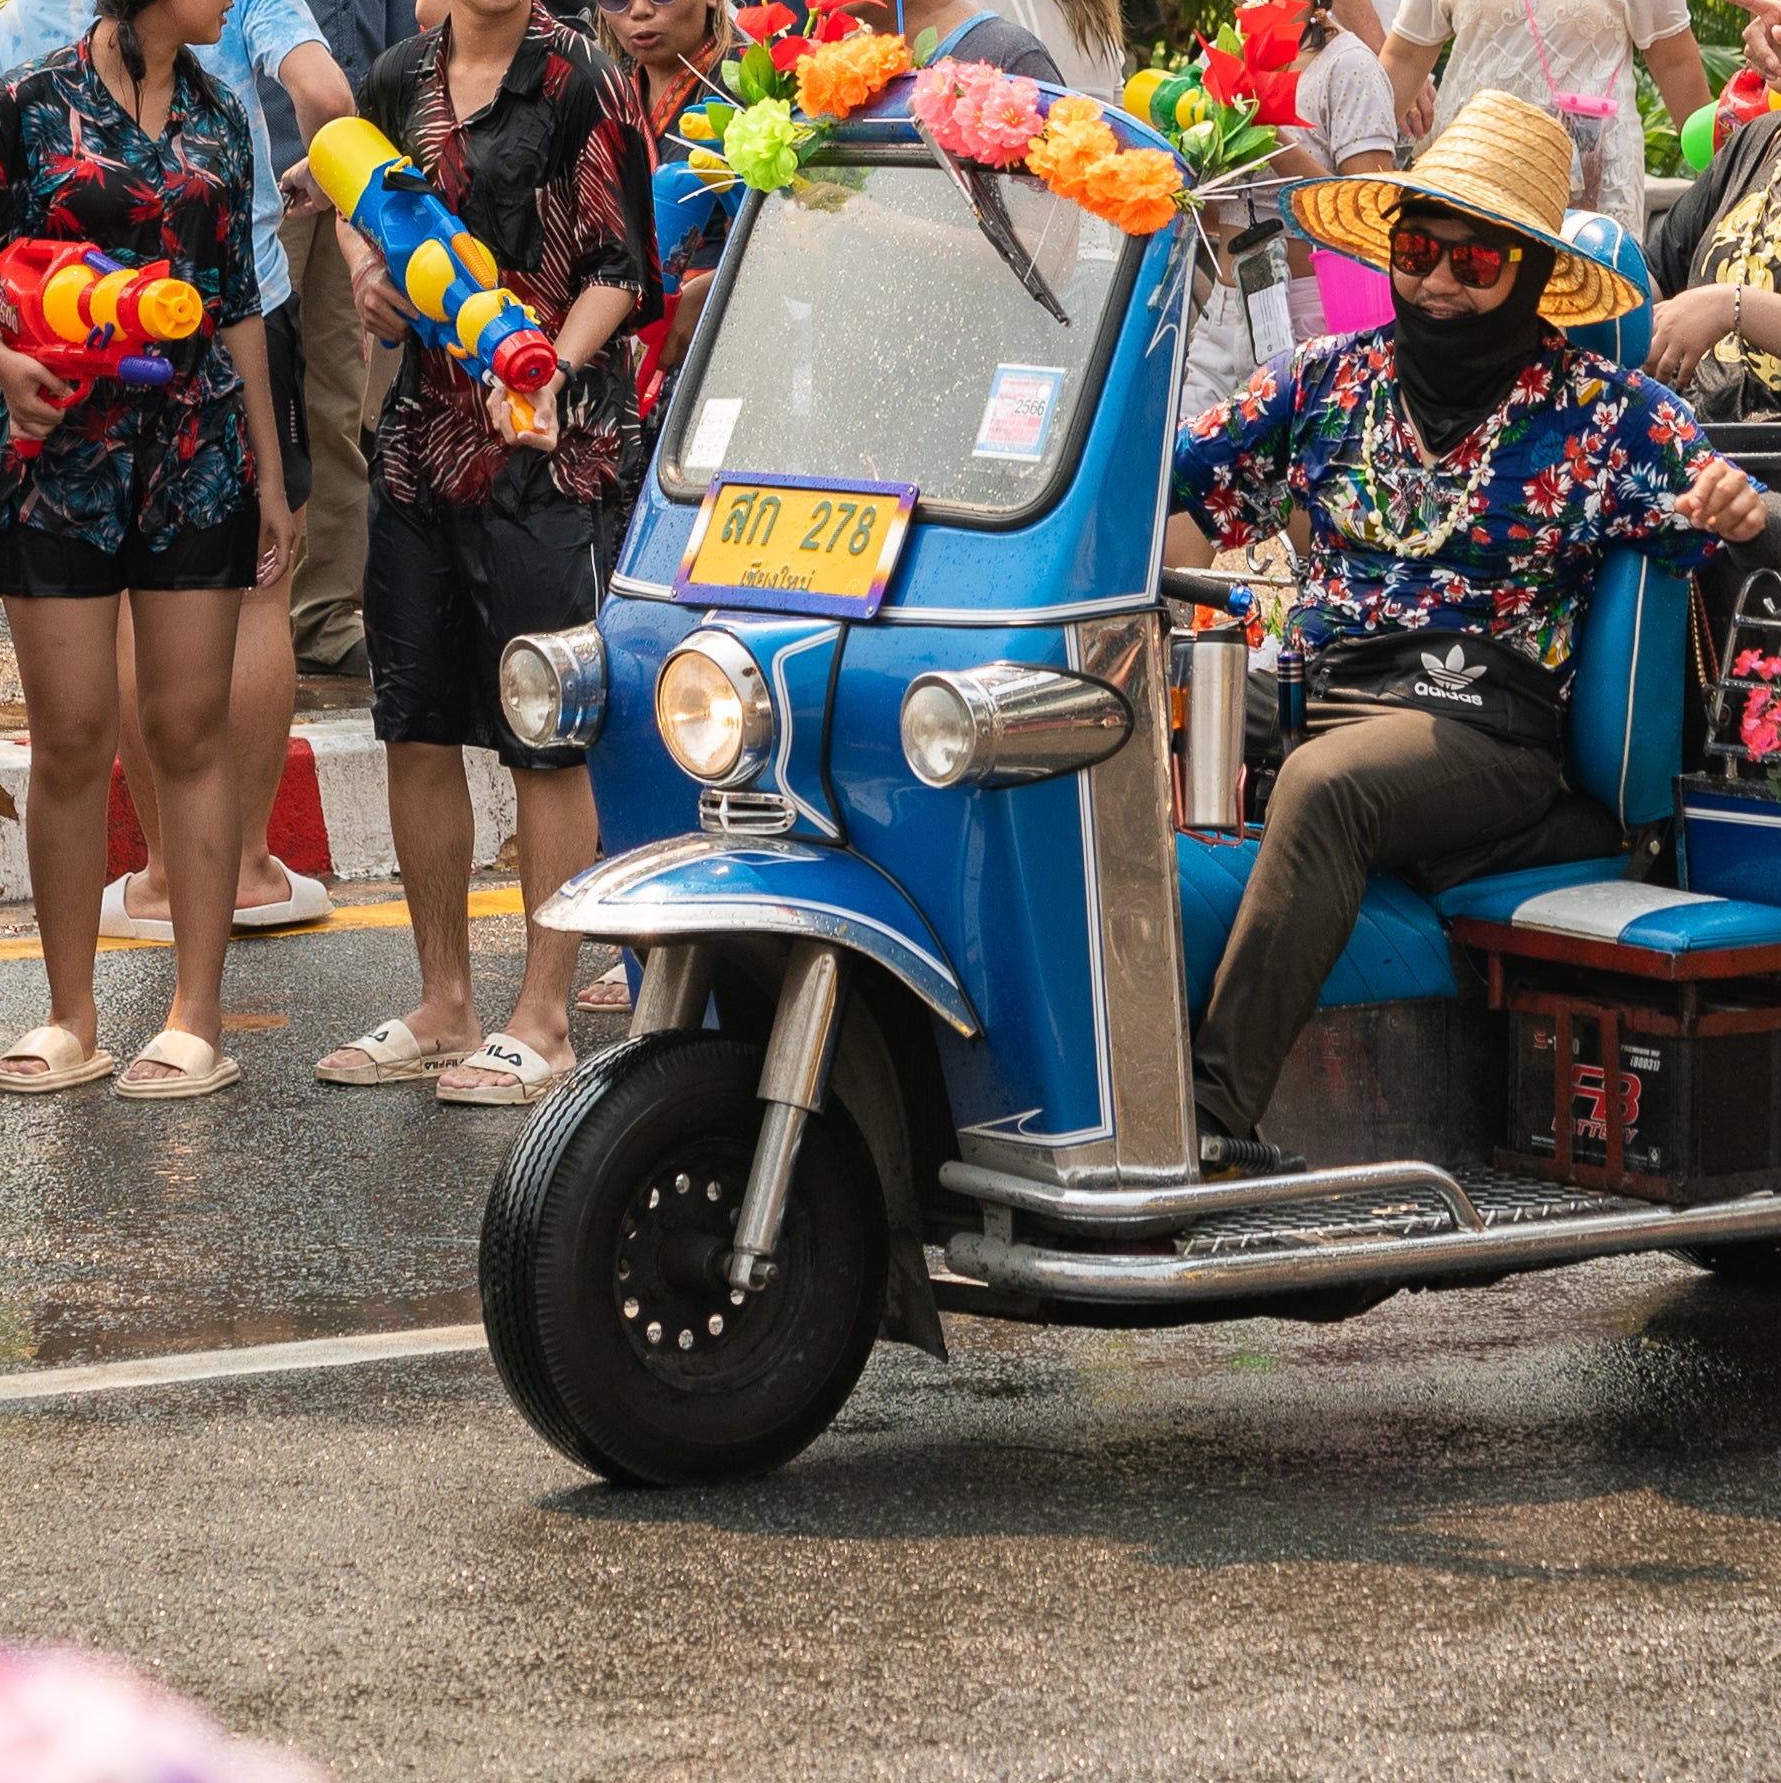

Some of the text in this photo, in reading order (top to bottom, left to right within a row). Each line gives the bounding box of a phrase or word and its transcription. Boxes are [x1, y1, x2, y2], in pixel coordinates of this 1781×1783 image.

[1014, 399, 1046, 416] 2566
[721, 489, 877, 556] สก 278
[1414, 681, 1484, 707] adidas
